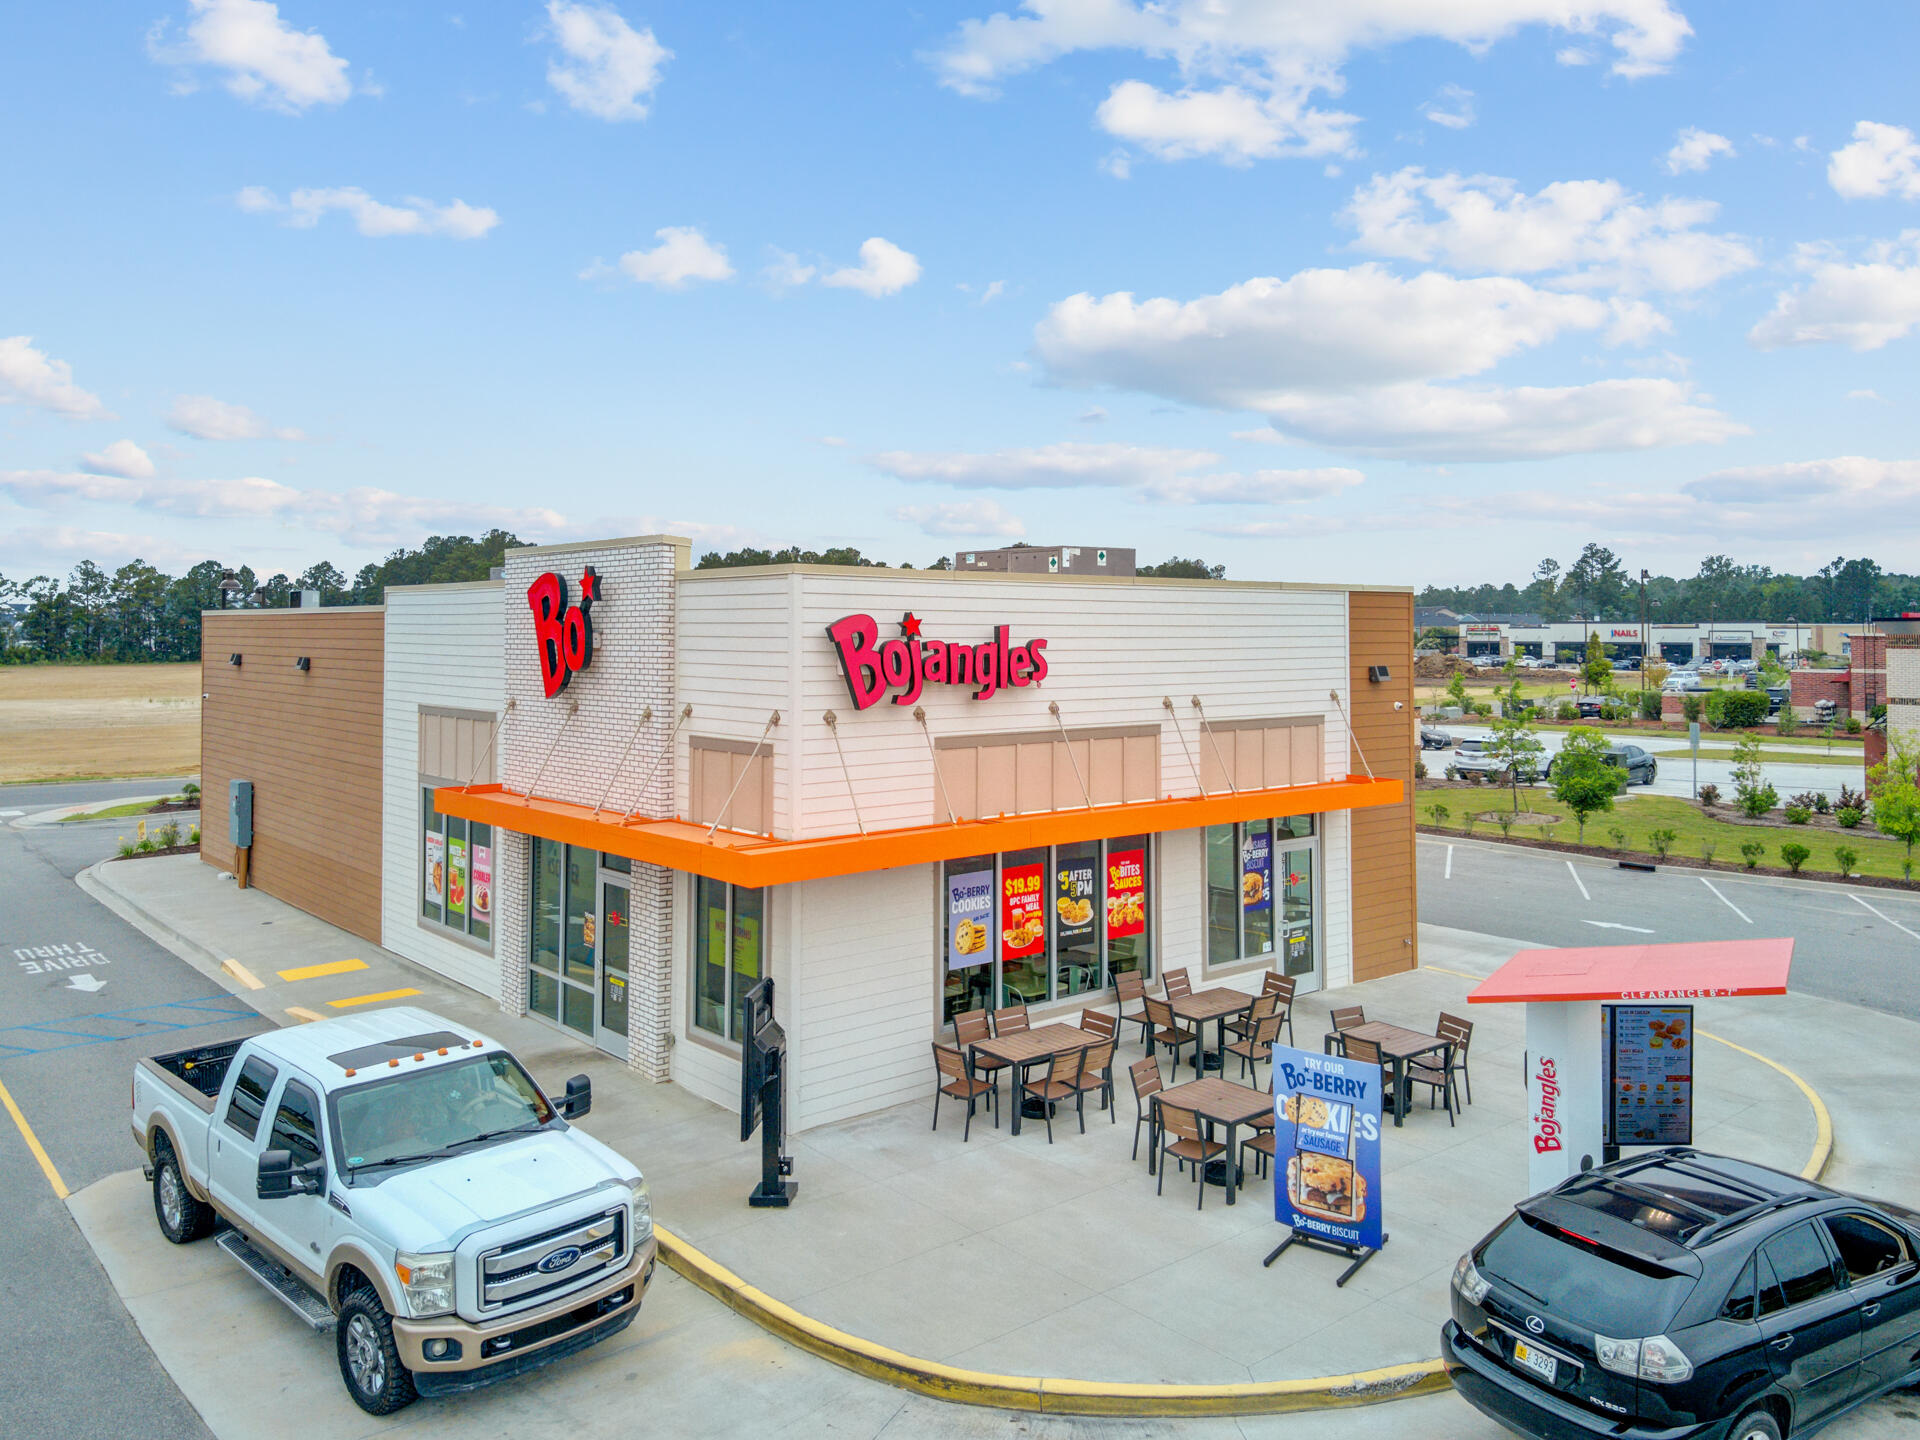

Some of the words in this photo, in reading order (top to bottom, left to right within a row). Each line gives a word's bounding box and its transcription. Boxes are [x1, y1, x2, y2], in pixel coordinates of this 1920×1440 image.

[826, 612, 1048, 710] Bojangles
[1069, 868, 1092, 882] AFTER
[1114, 875, 1142, 891] SAUCES
[1263, 869, 1269, 883] 2
[1005, 875, 1041, 897] $19.99
[1070, 880, 1093, 898] 5PM
[951, 895, 991, 914] COOKIES
[13, 942, 96, 960] THRU
[18, 952, 112, 974] DRIVE
[1621, 989, 1704, 1000] CLEARANCE
[1304, 1057, 1322, 1070] TRY
[1323, 1061, 1344, 1075] OUR
[1534, 1056, 1562, 1154] Bojangles
[1303, 1134, 1341, 1152] SAUSAGE
[1331, 1226, 1360, 1240] BISCUIT
[549, 1252, 573, 1268] Ford
[1533, 1353, 1554, 1374] 3293
